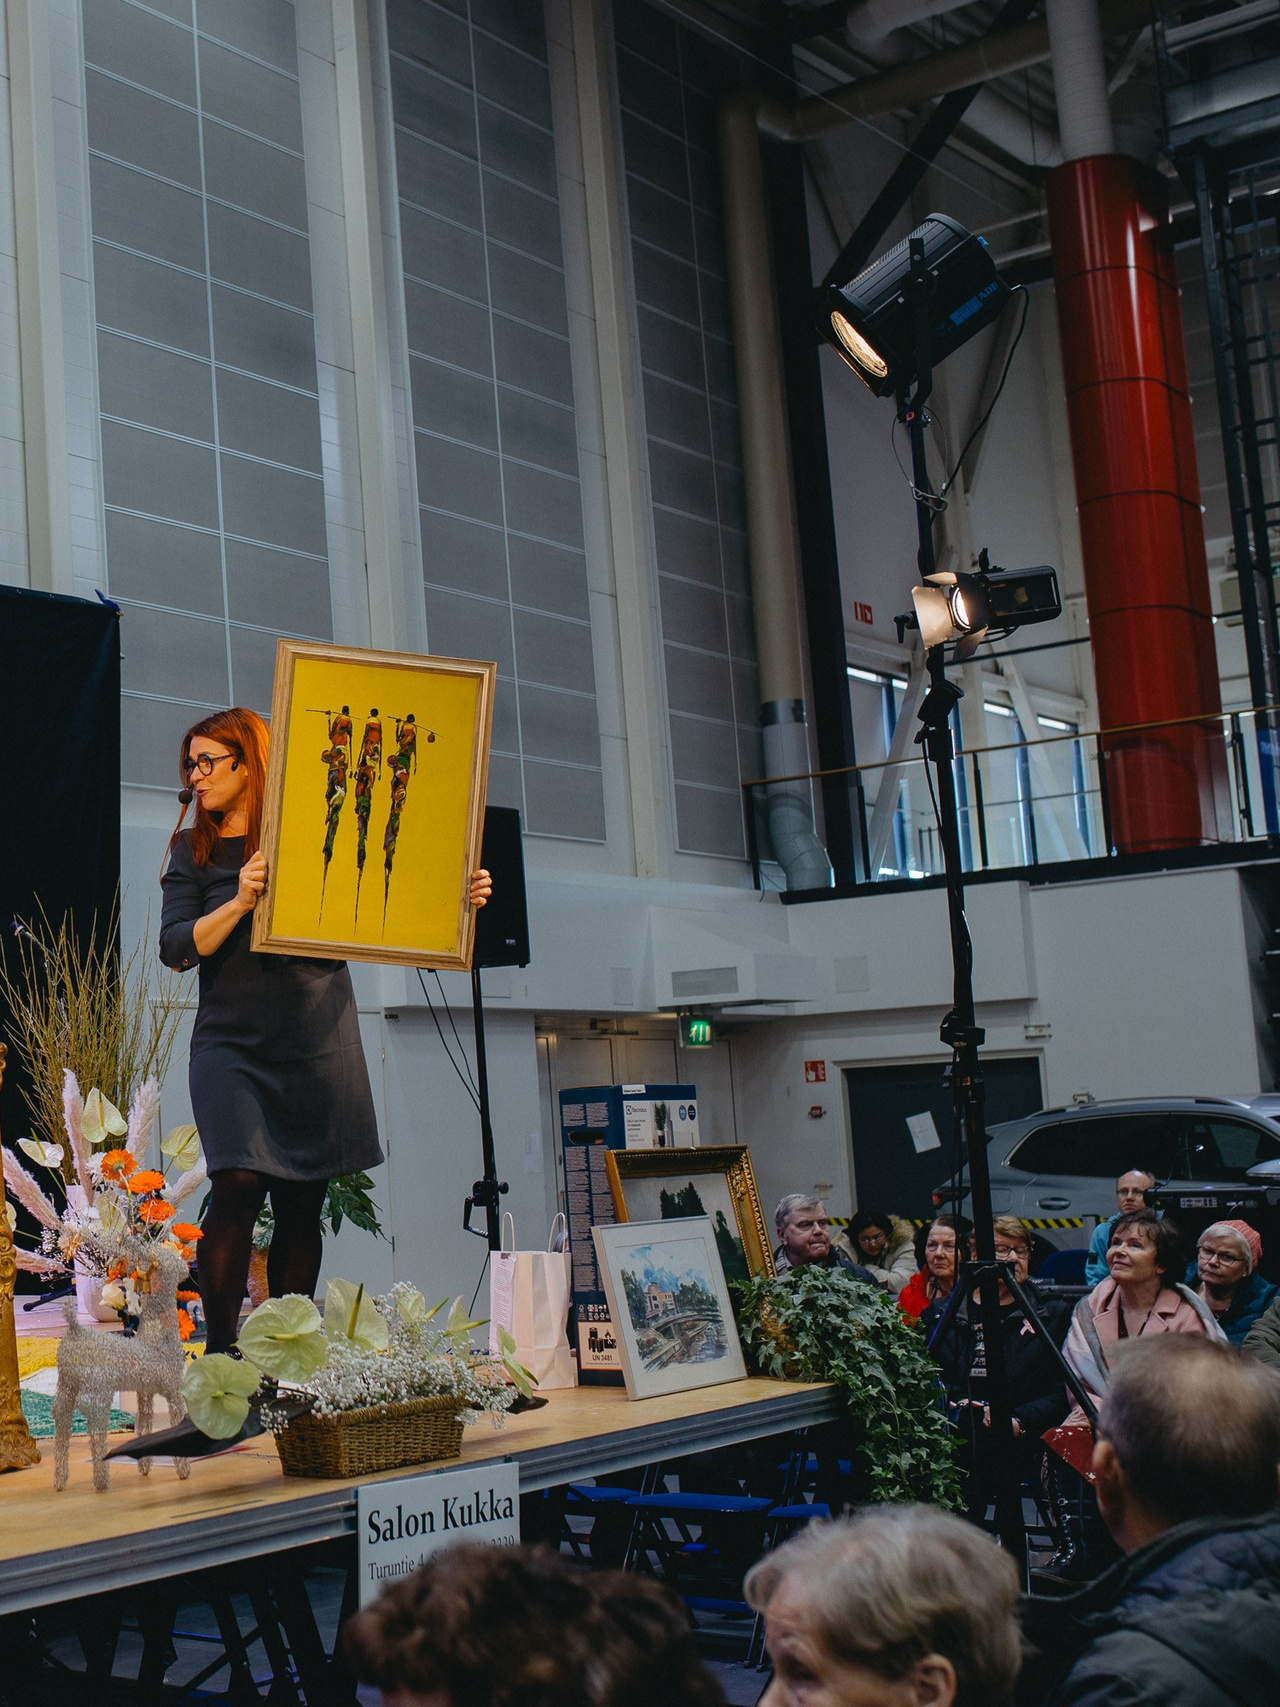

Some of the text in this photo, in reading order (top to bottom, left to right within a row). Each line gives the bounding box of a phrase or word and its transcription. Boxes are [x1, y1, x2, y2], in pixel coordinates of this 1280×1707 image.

[368, 1488, 515, 1545] Salon Kukka
[368, 1556, 415, 1580] Turuntie
